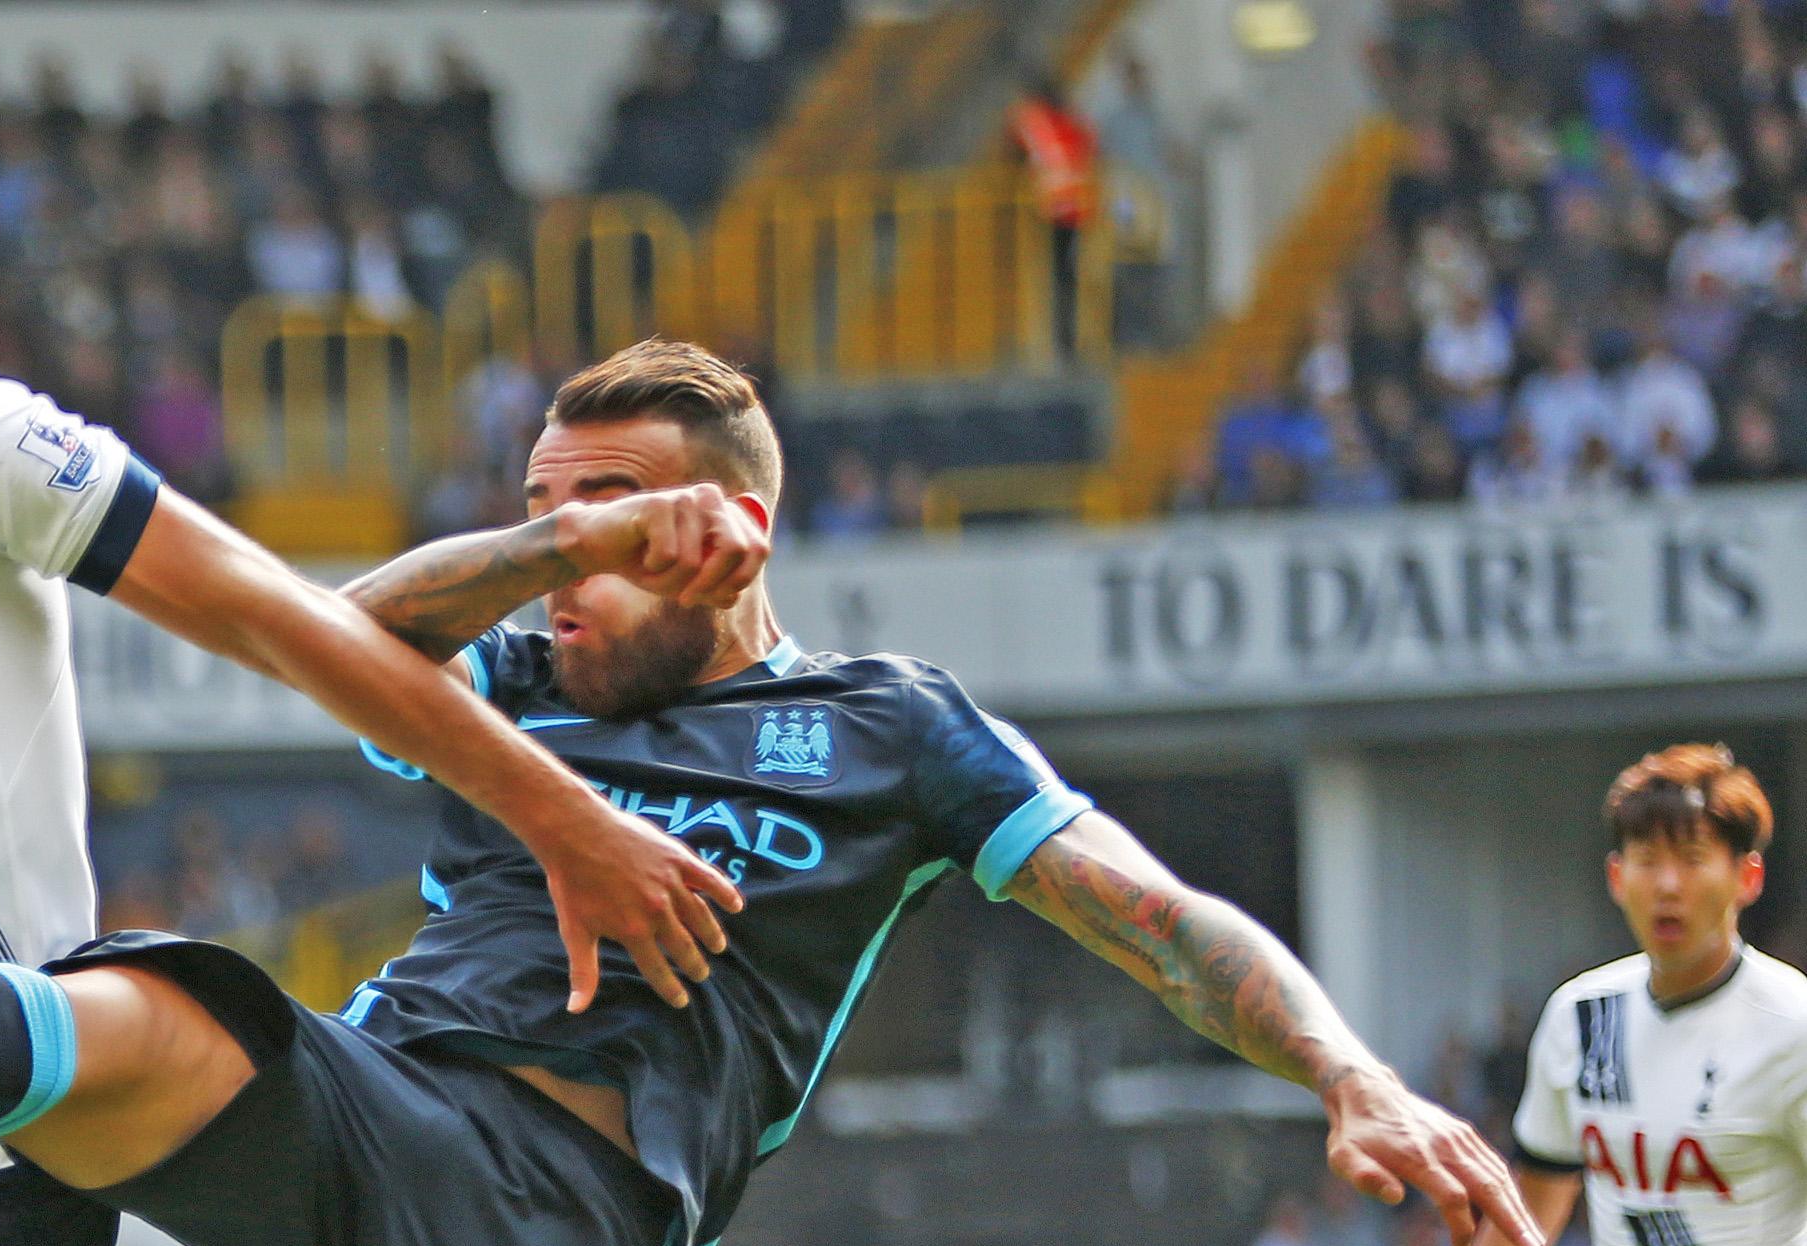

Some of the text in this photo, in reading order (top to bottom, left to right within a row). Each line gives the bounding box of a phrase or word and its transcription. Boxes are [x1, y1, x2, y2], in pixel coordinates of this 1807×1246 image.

[1097, 515, 1768, 682] TO DARE IS
[1580, 1123, 1733, 1199] AIA
